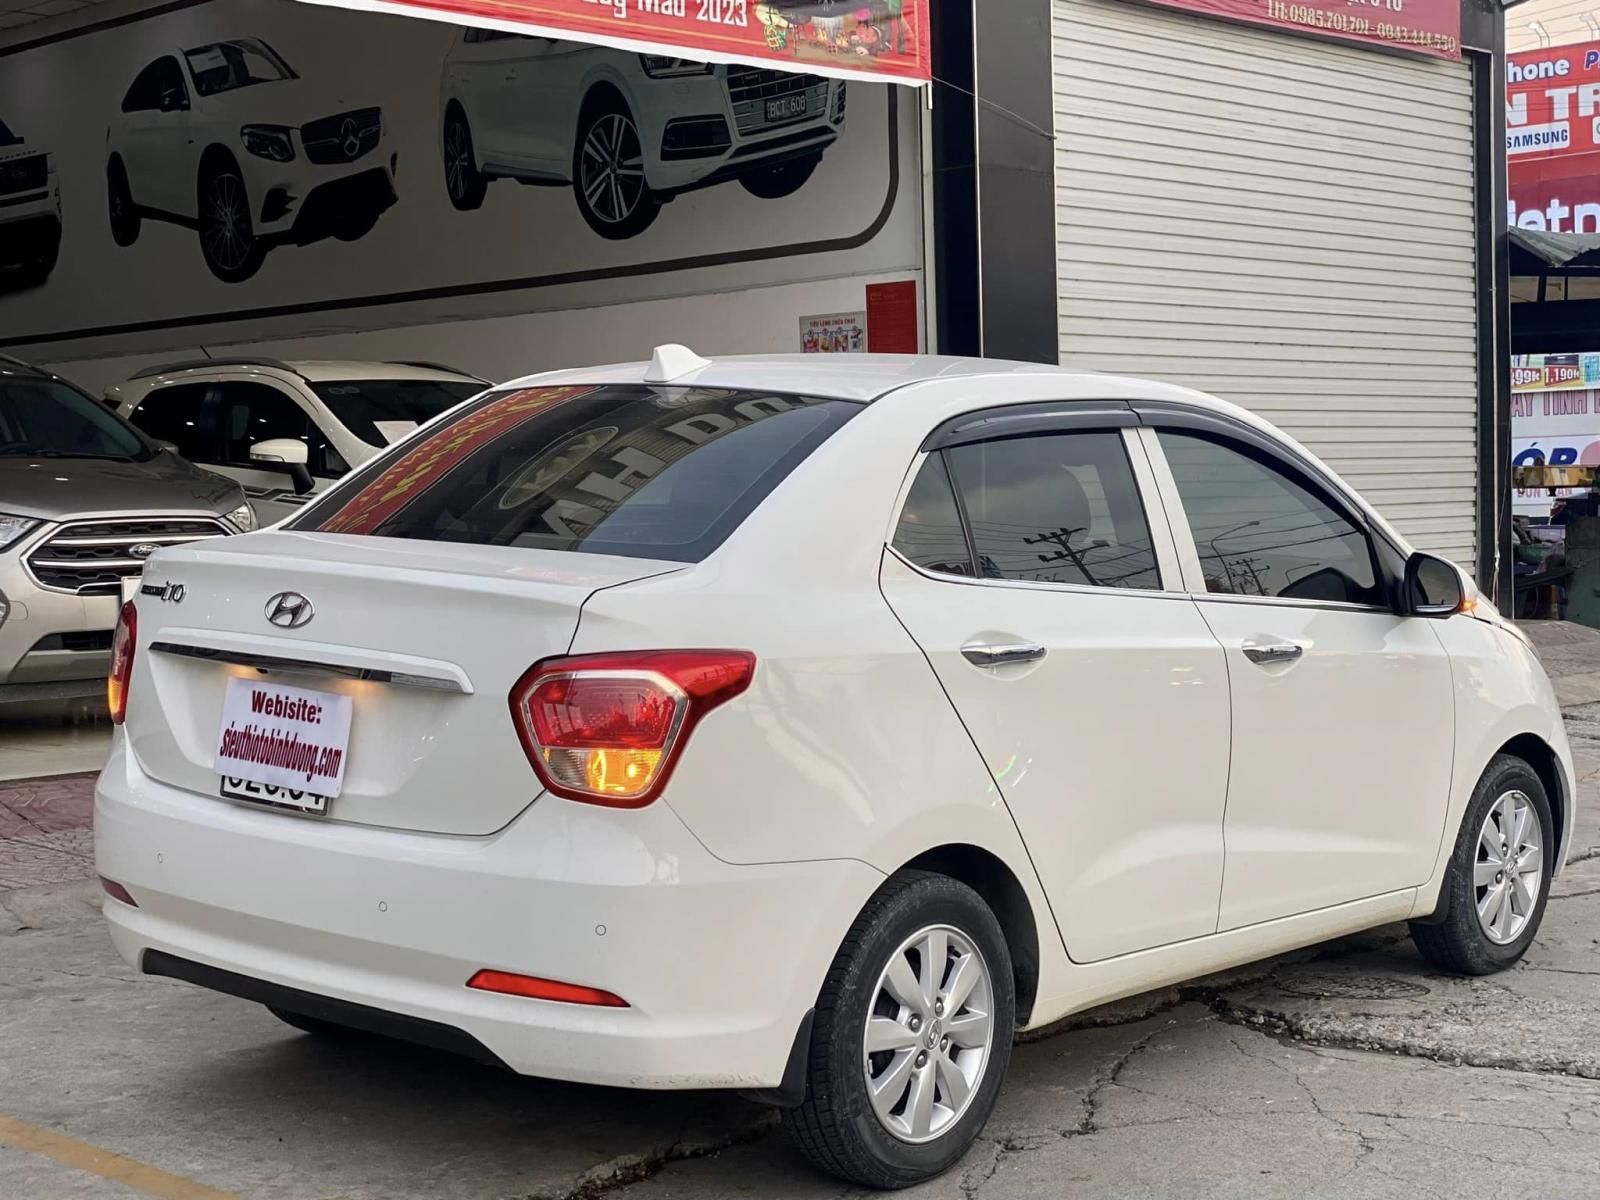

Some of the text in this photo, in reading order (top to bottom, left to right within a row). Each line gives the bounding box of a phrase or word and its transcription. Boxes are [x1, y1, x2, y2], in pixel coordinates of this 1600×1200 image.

[696, 0, 748, 27] 2023
[1506, 128, 1568, 149] SAMSUNG
[160, 579, 187, 603] i10
[251, 689, 323, 725] Webisite:
[219, 720, 343, 783] sieuthiotobinhduong.com
